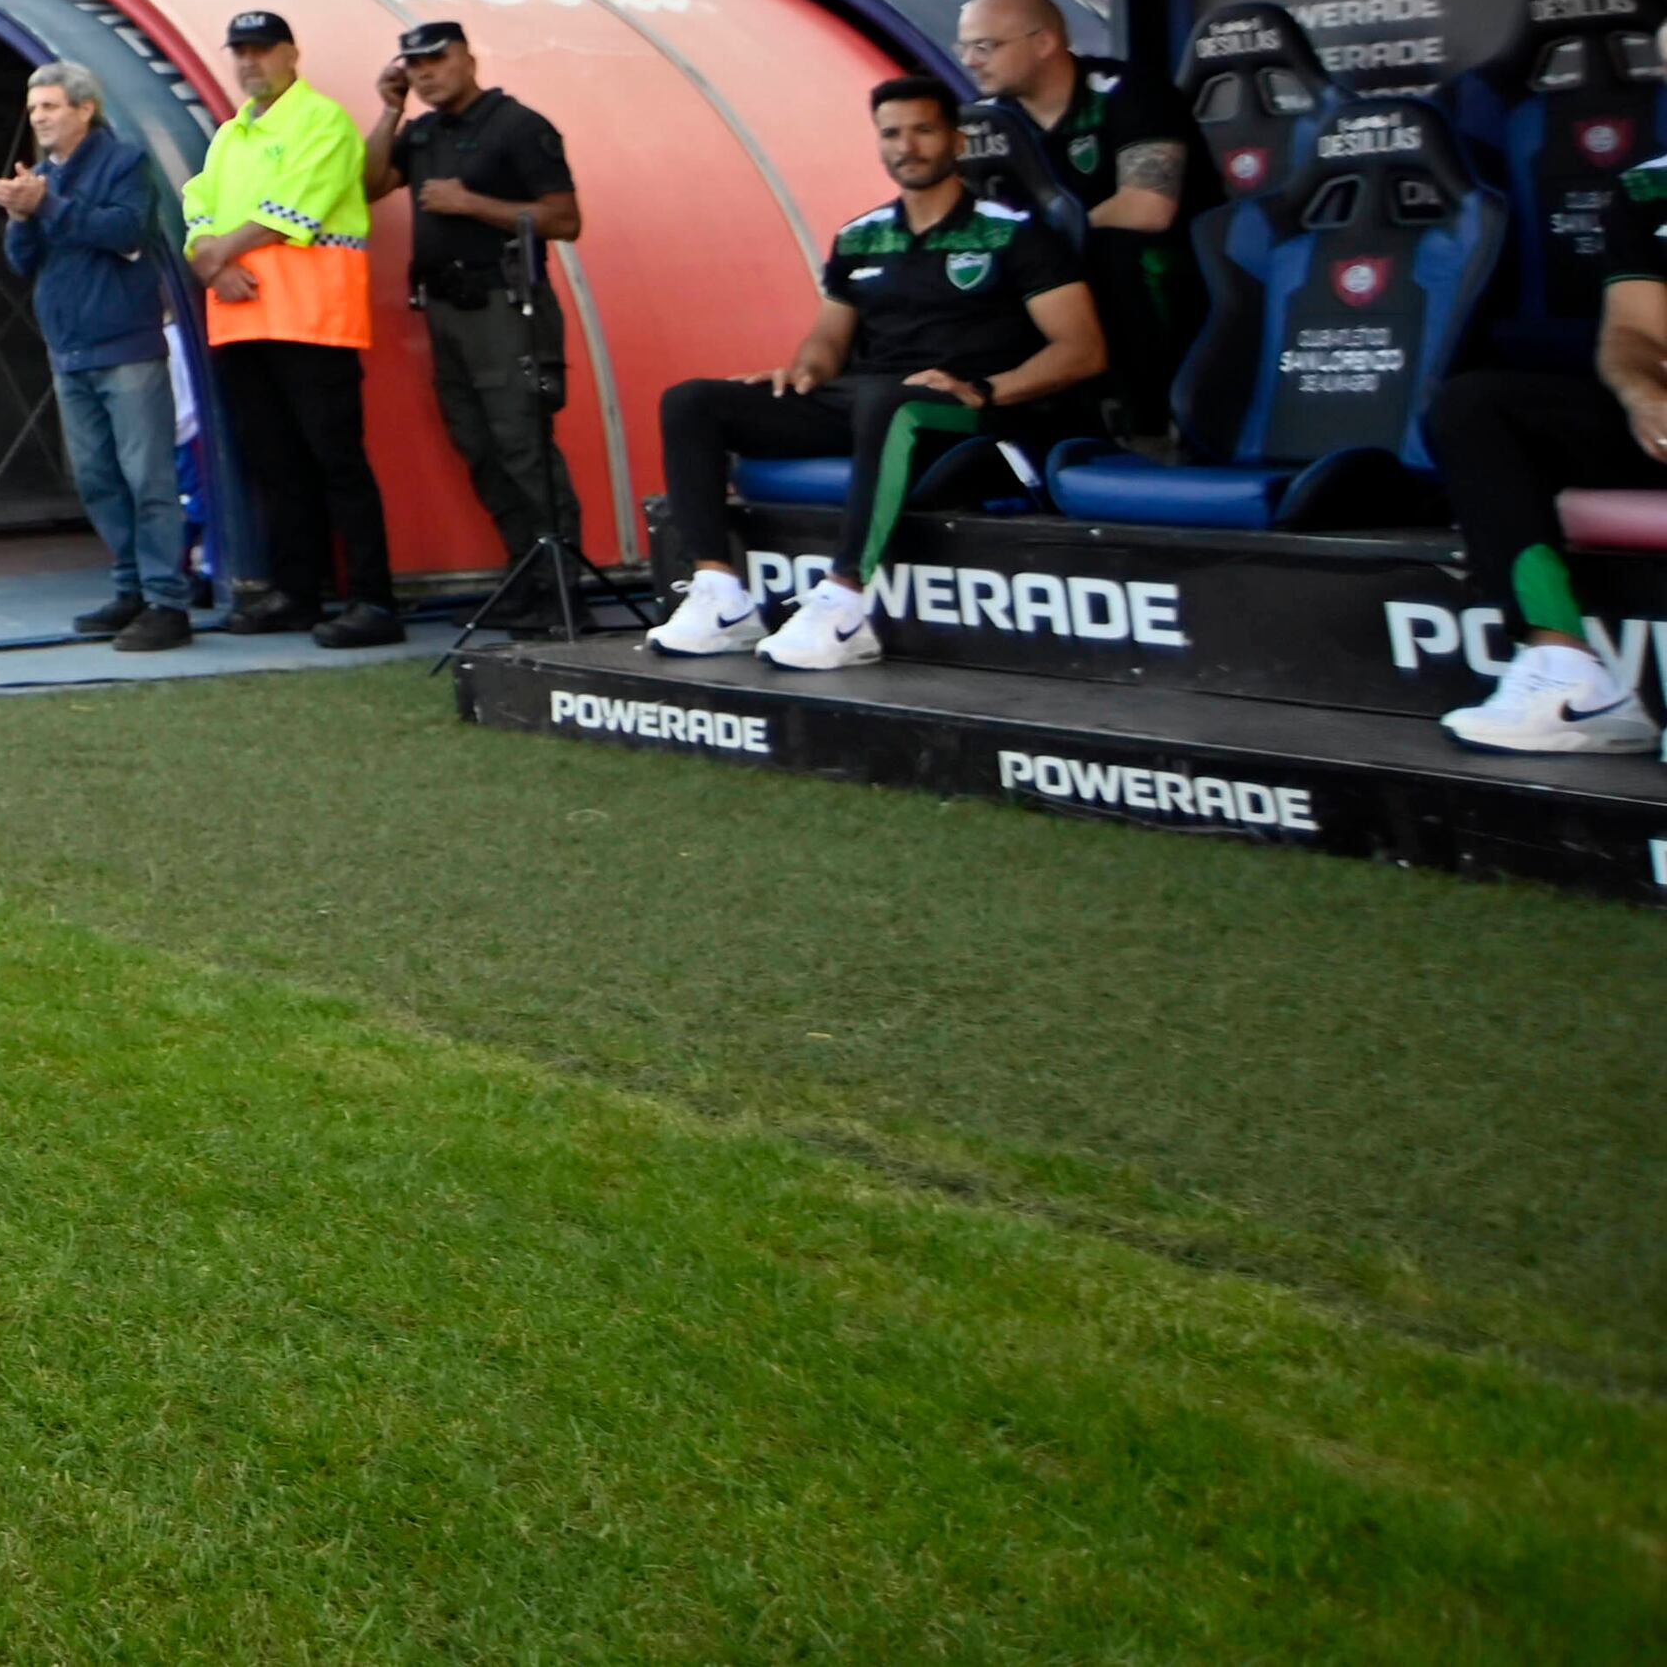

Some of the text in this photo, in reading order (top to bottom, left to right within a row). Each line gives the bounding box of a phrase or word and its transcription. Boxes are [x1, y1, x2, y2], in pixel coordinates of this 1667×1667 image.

[1316, 37, 1446, 72] ERADE
[551, 690, 770, 754] POWERADE
[998, 749, 1319, 830] POWERADE
